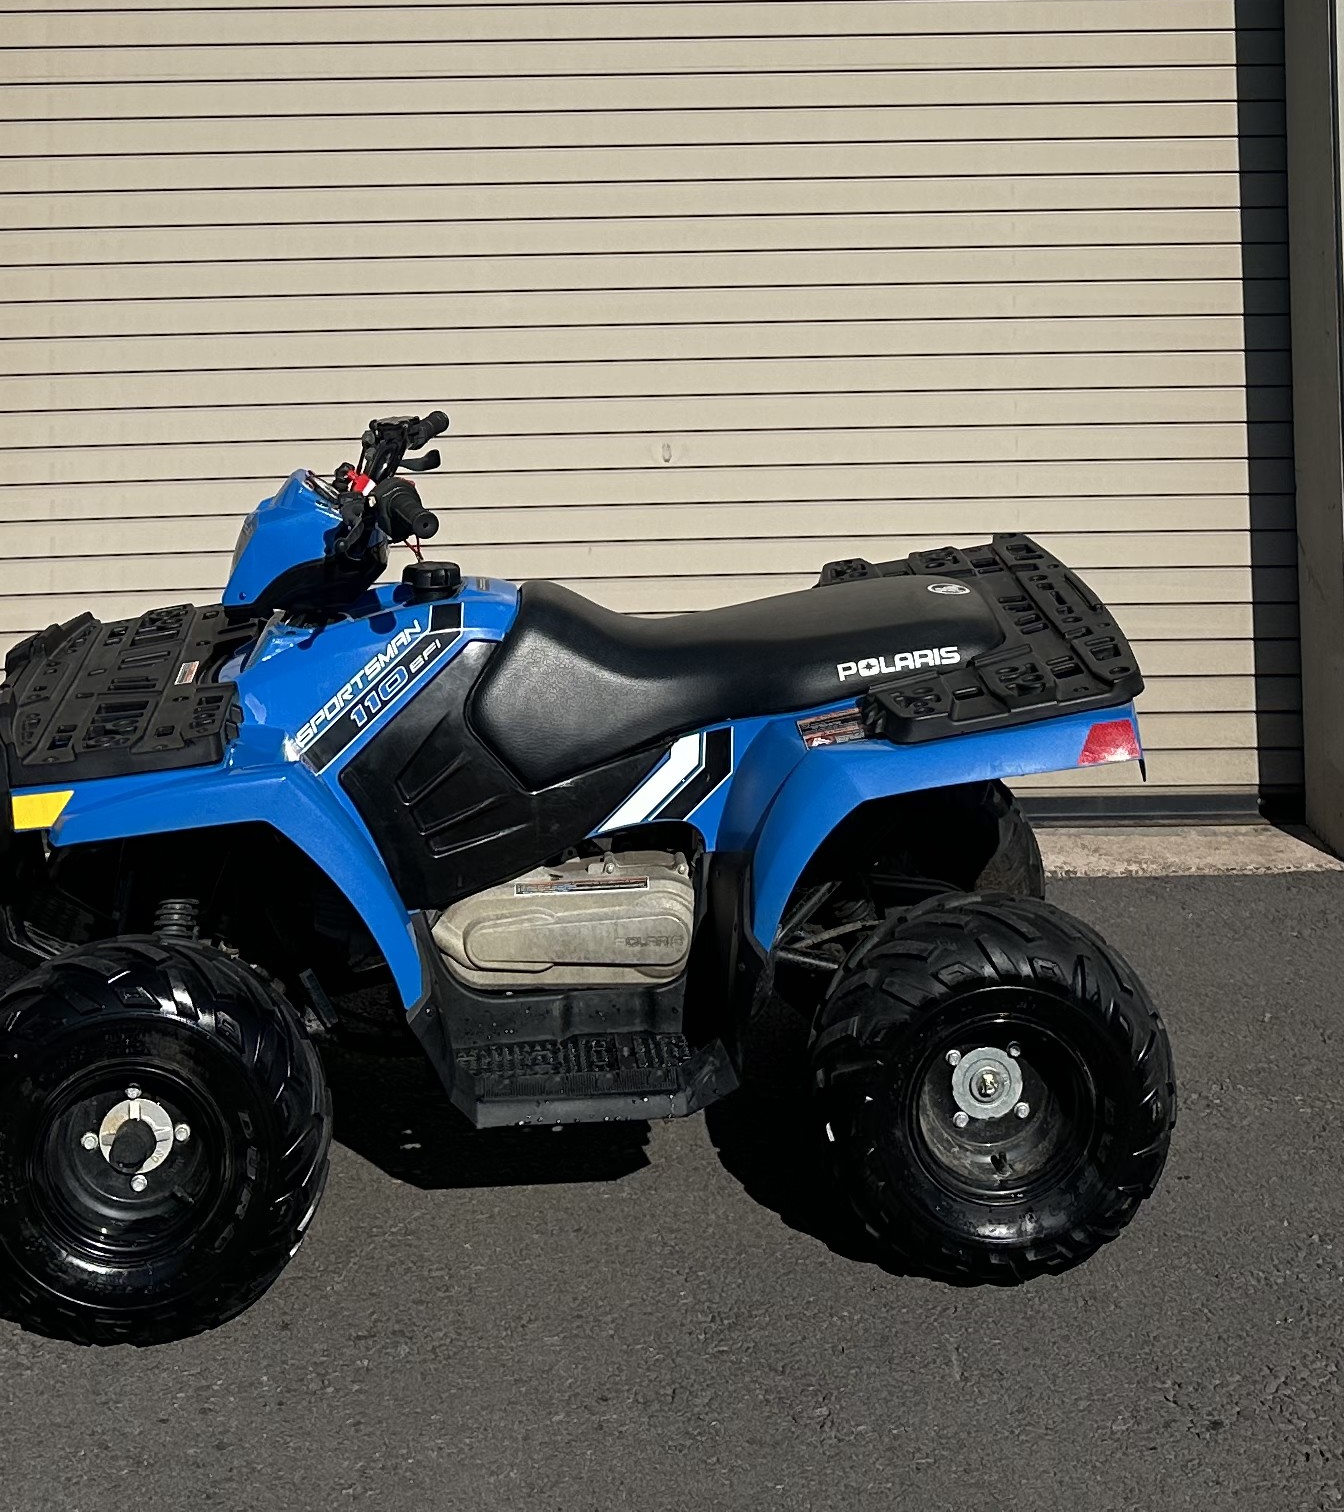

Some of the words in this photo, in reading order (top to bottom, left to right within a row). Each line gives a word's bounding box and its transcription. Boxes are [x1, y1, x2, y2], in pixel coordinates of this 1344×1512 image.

[295, 619, 423, 748] SPORTSMAN
[836, 646, 961, 682] POLARIS
[350, 665, 409, 728] 110
